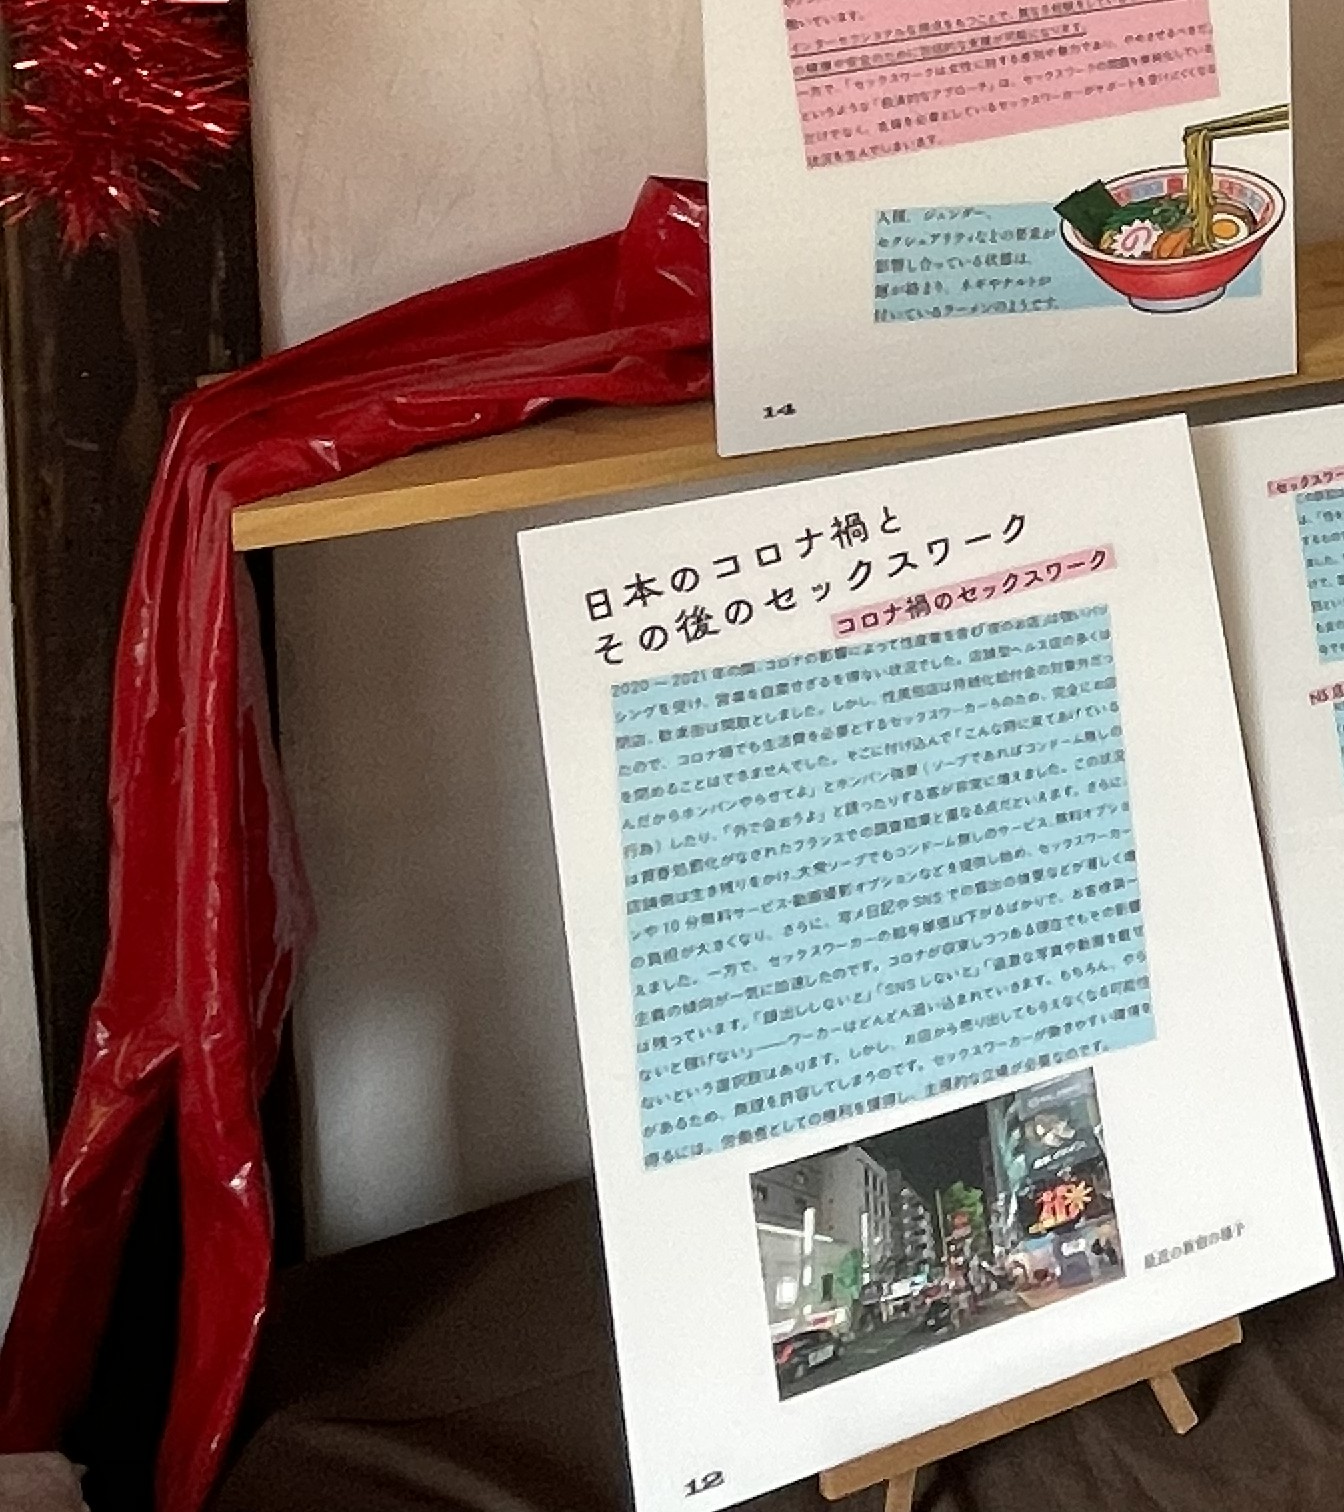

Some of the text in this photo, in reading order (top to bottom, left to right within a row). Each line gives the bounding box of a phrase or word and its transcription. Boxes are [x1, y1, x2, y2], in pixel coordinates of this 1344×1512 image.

[763, 403, 796, 419] 14
[585, 506, 903, 624] 日本のコロナ禍と
[594, 513, 1029, 666] その後のセックスワーク
[837, 549, 1107, 634] コロナ禍のセックスワーク
[684, 1470, 726, 1498] 12
